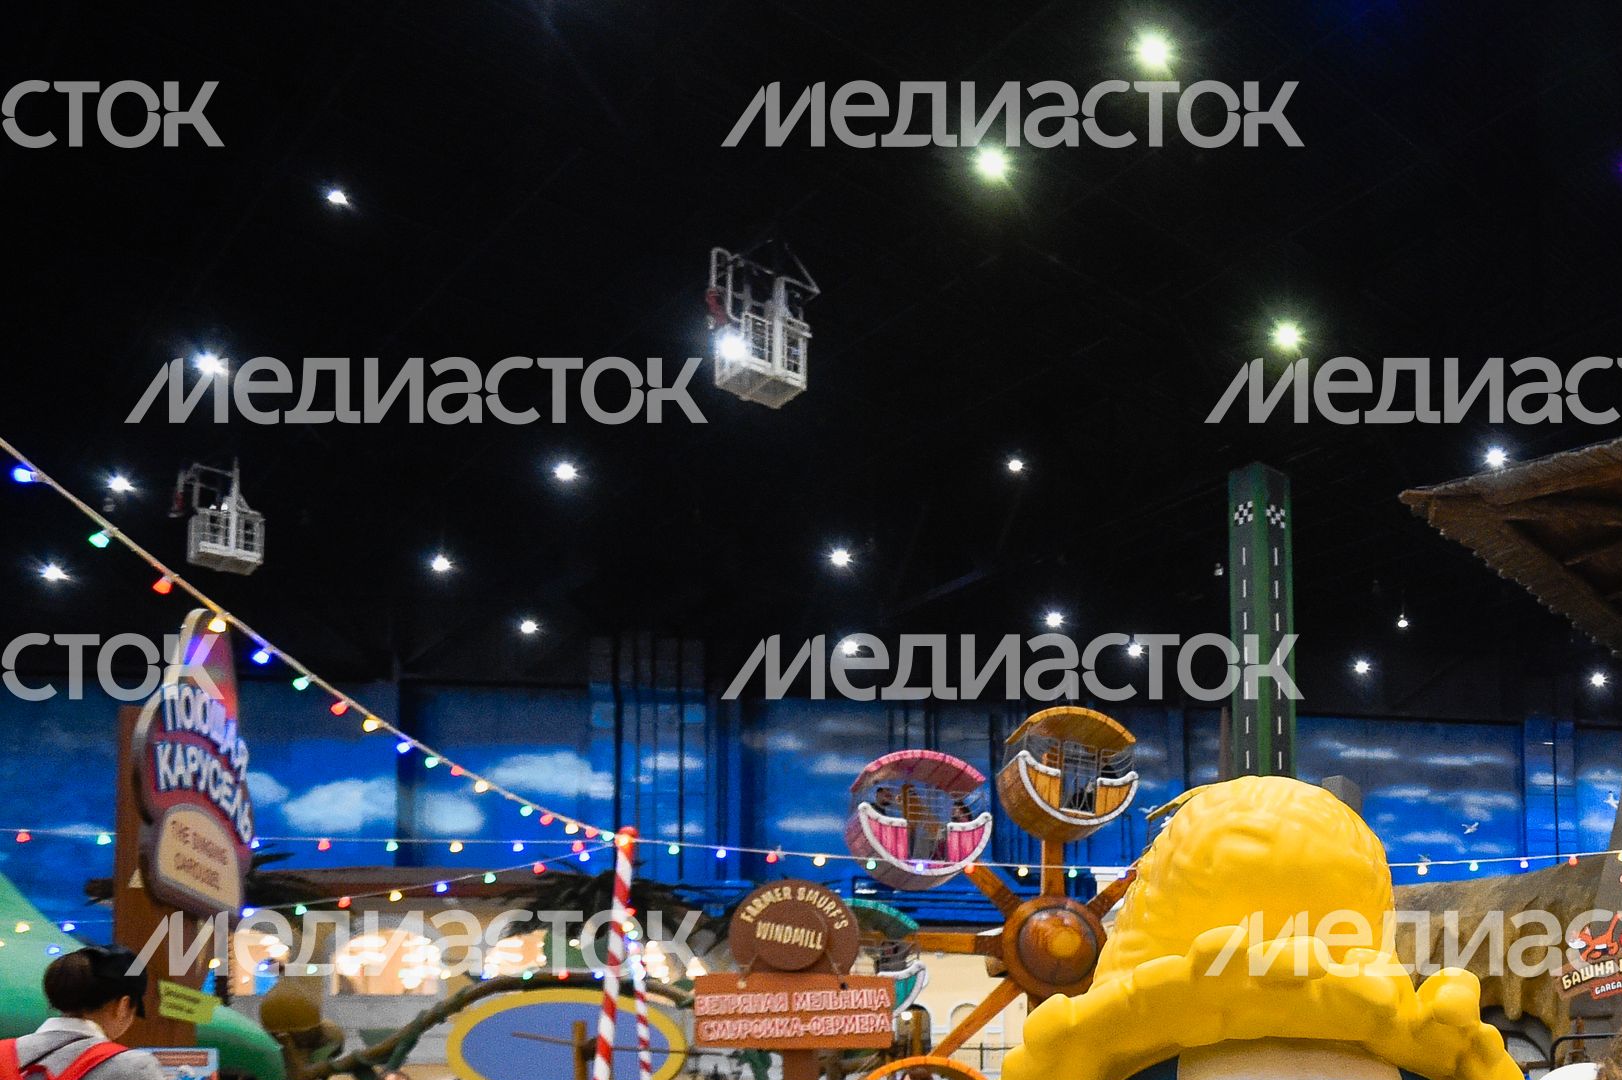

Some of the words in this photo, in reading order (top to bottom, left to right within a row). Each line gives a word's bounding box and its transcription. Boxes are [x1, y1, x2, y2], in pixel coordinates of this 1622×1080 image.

[740, 886, 793, 924] FARMER
[797, 887, 849, 931] SMURF'S
[756, 921, 824, 950] WINDMILL
[1561, 959, 1616, 990] БАШНЯ
[792, 988, 892, 1013] МЕЛЬНИЦА
